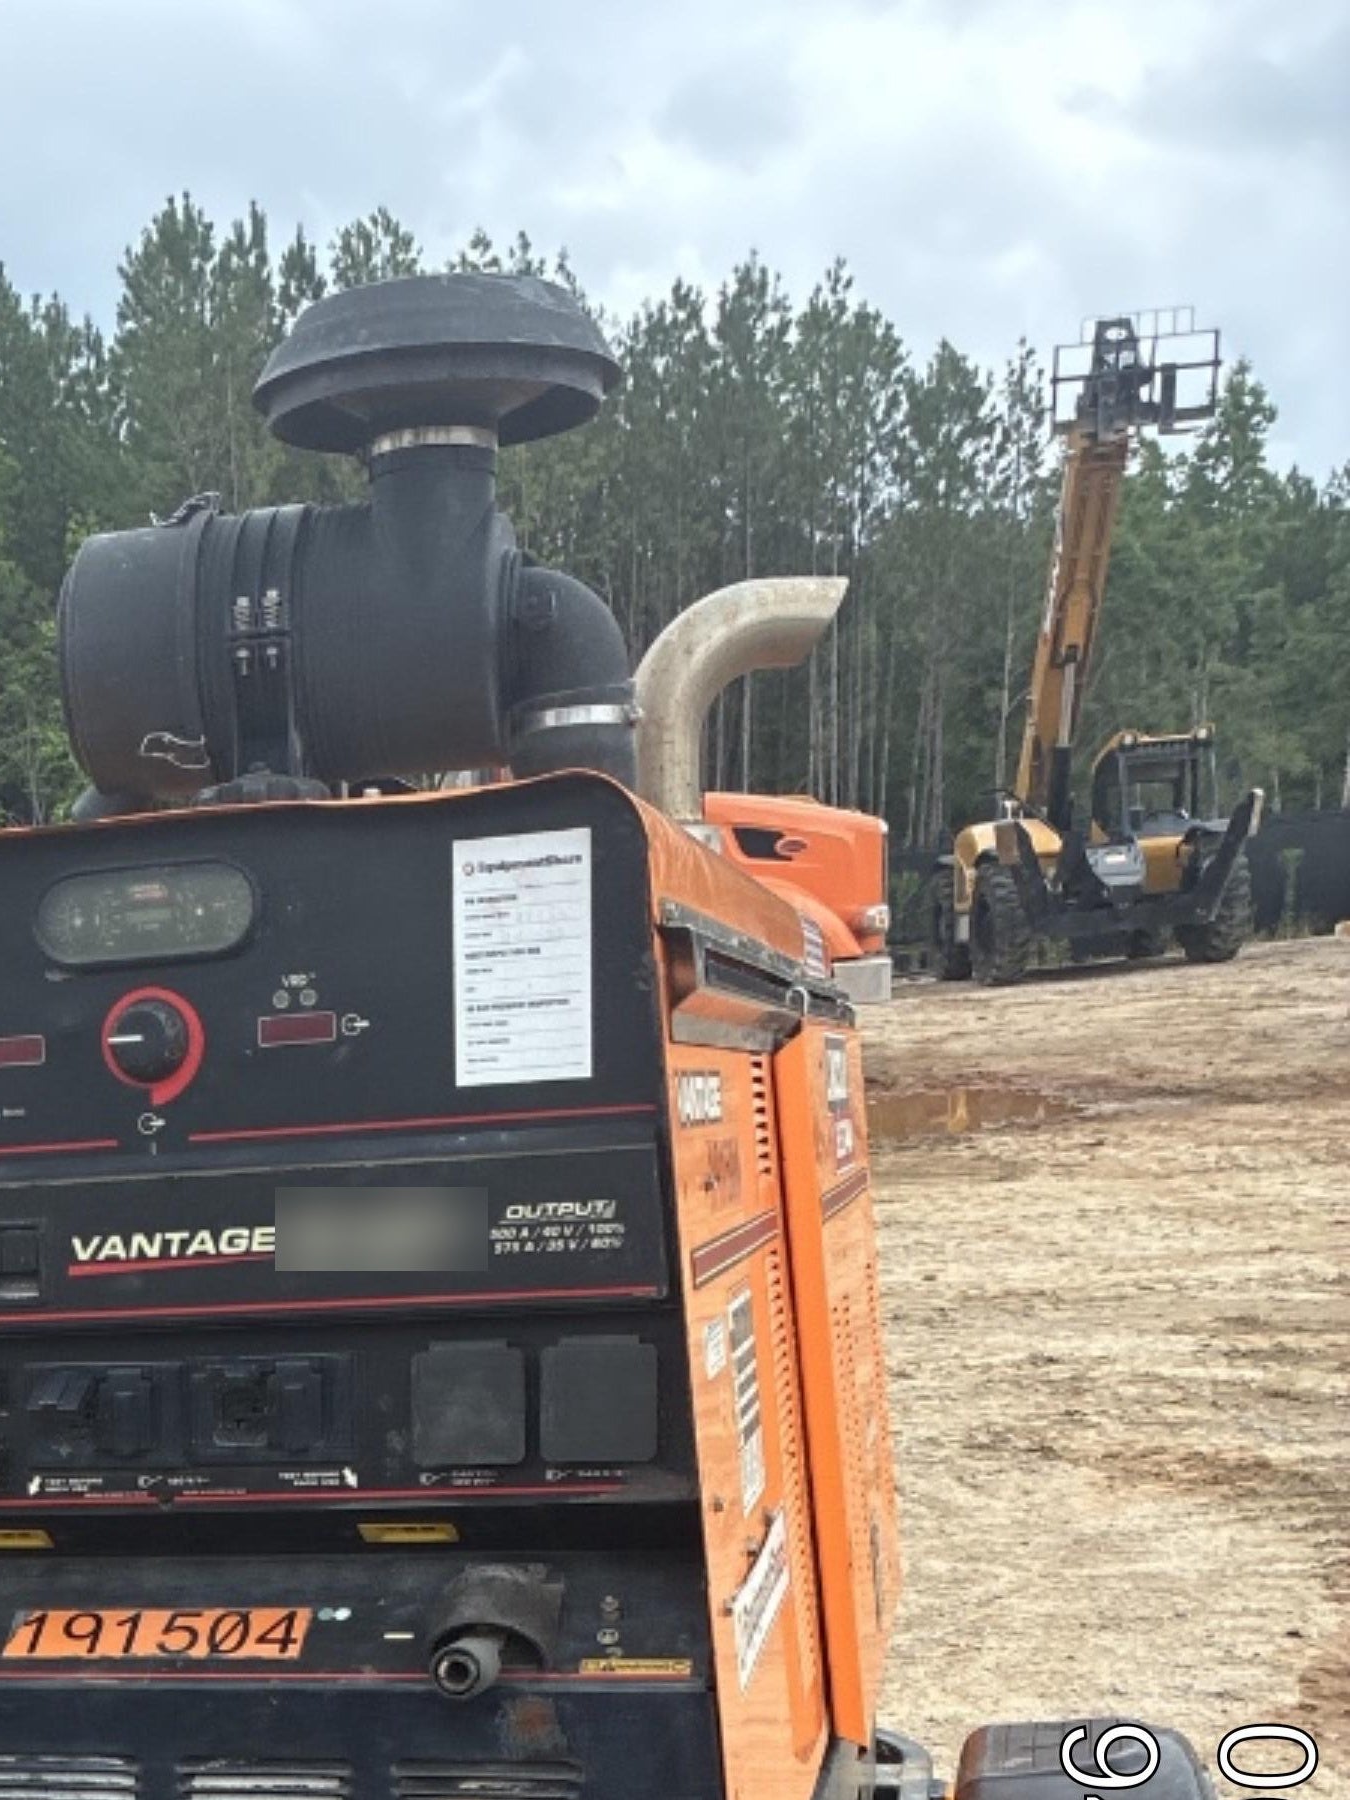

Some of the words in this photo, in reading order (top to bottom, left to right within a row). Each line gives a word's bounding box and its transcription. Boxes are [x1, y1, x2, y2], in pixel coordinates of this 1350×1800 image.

[505, 1199, 610, 1219] OUTPUT
[71, 1226, 276, 1262] VANTAGE
[19, 1609, 303, 1655] 191504
